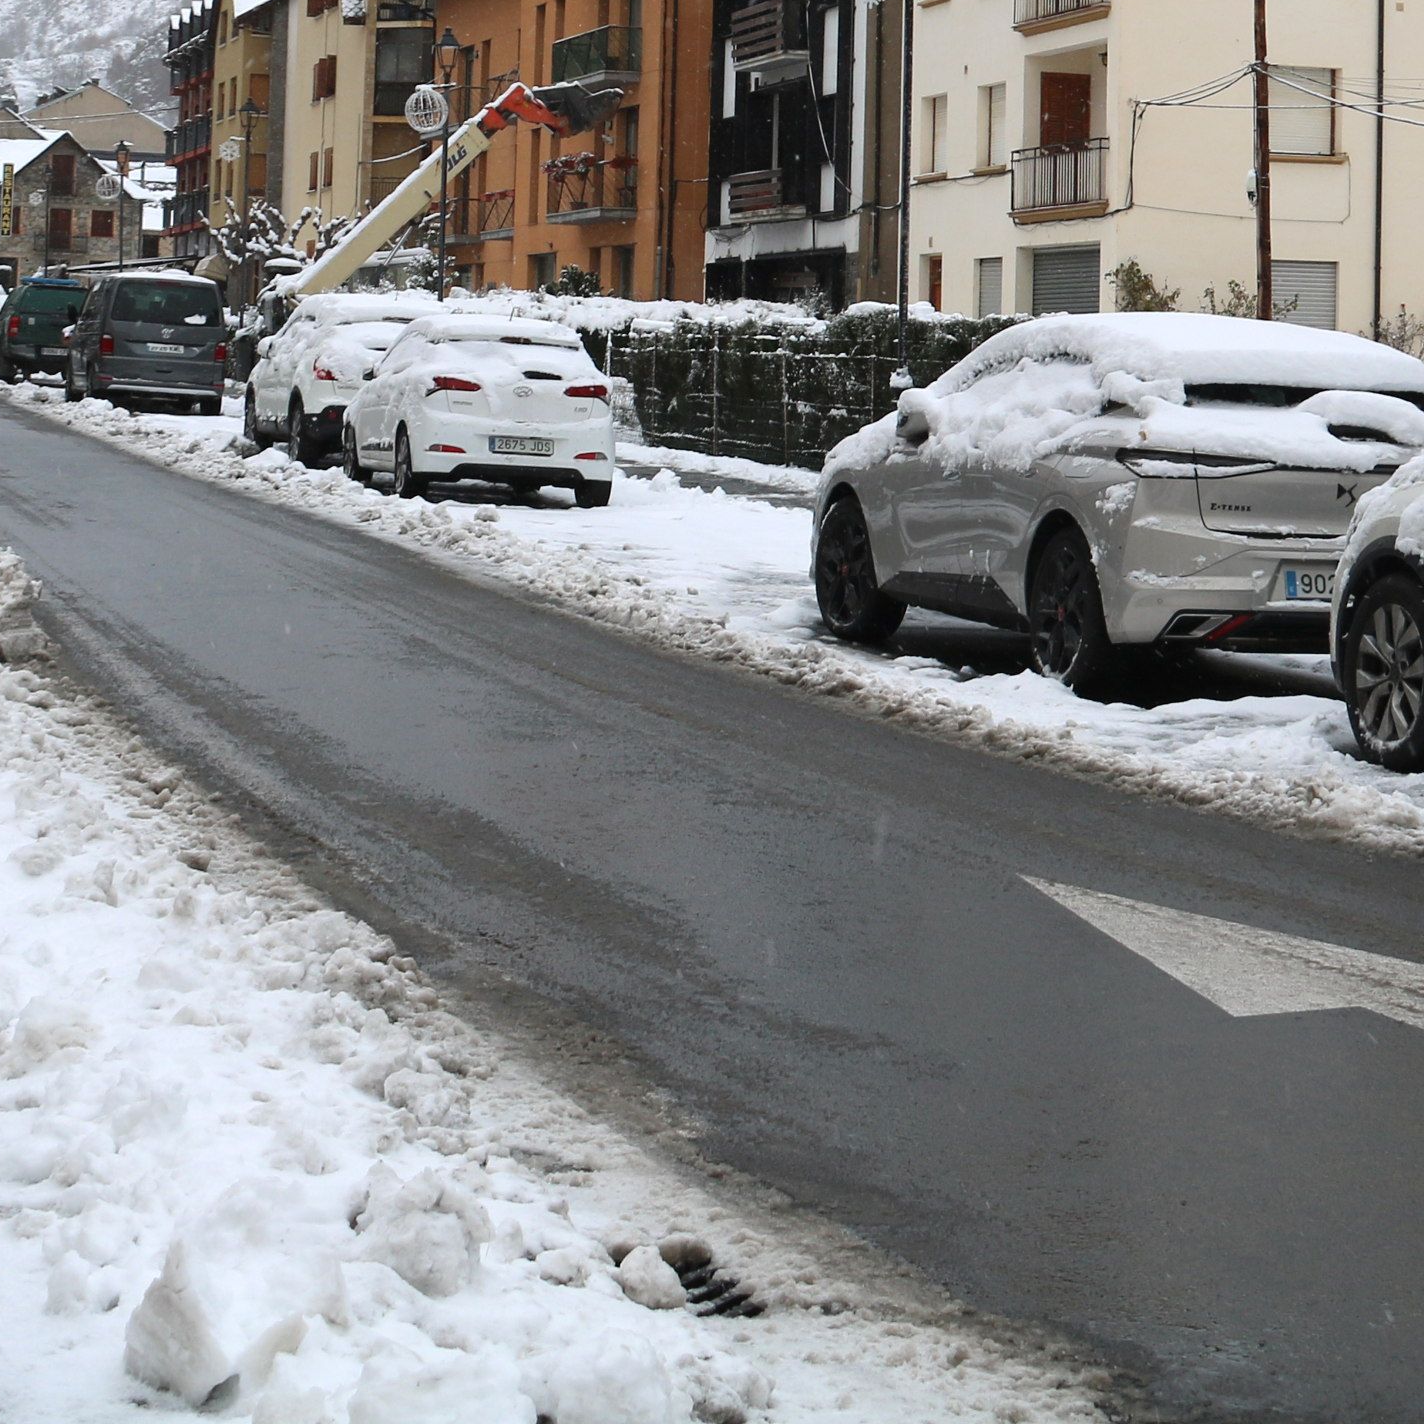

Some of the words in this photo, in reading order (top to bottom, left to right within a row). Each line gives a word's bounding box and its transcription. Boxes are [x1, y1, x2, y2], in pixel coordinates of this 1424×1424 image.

[447, 145, 468, 172] JLG
[2, 165, 12, 235] RESTAURANT
[497, 438, 527, 451] 2675
[530, 441, 551, 453] JDS
